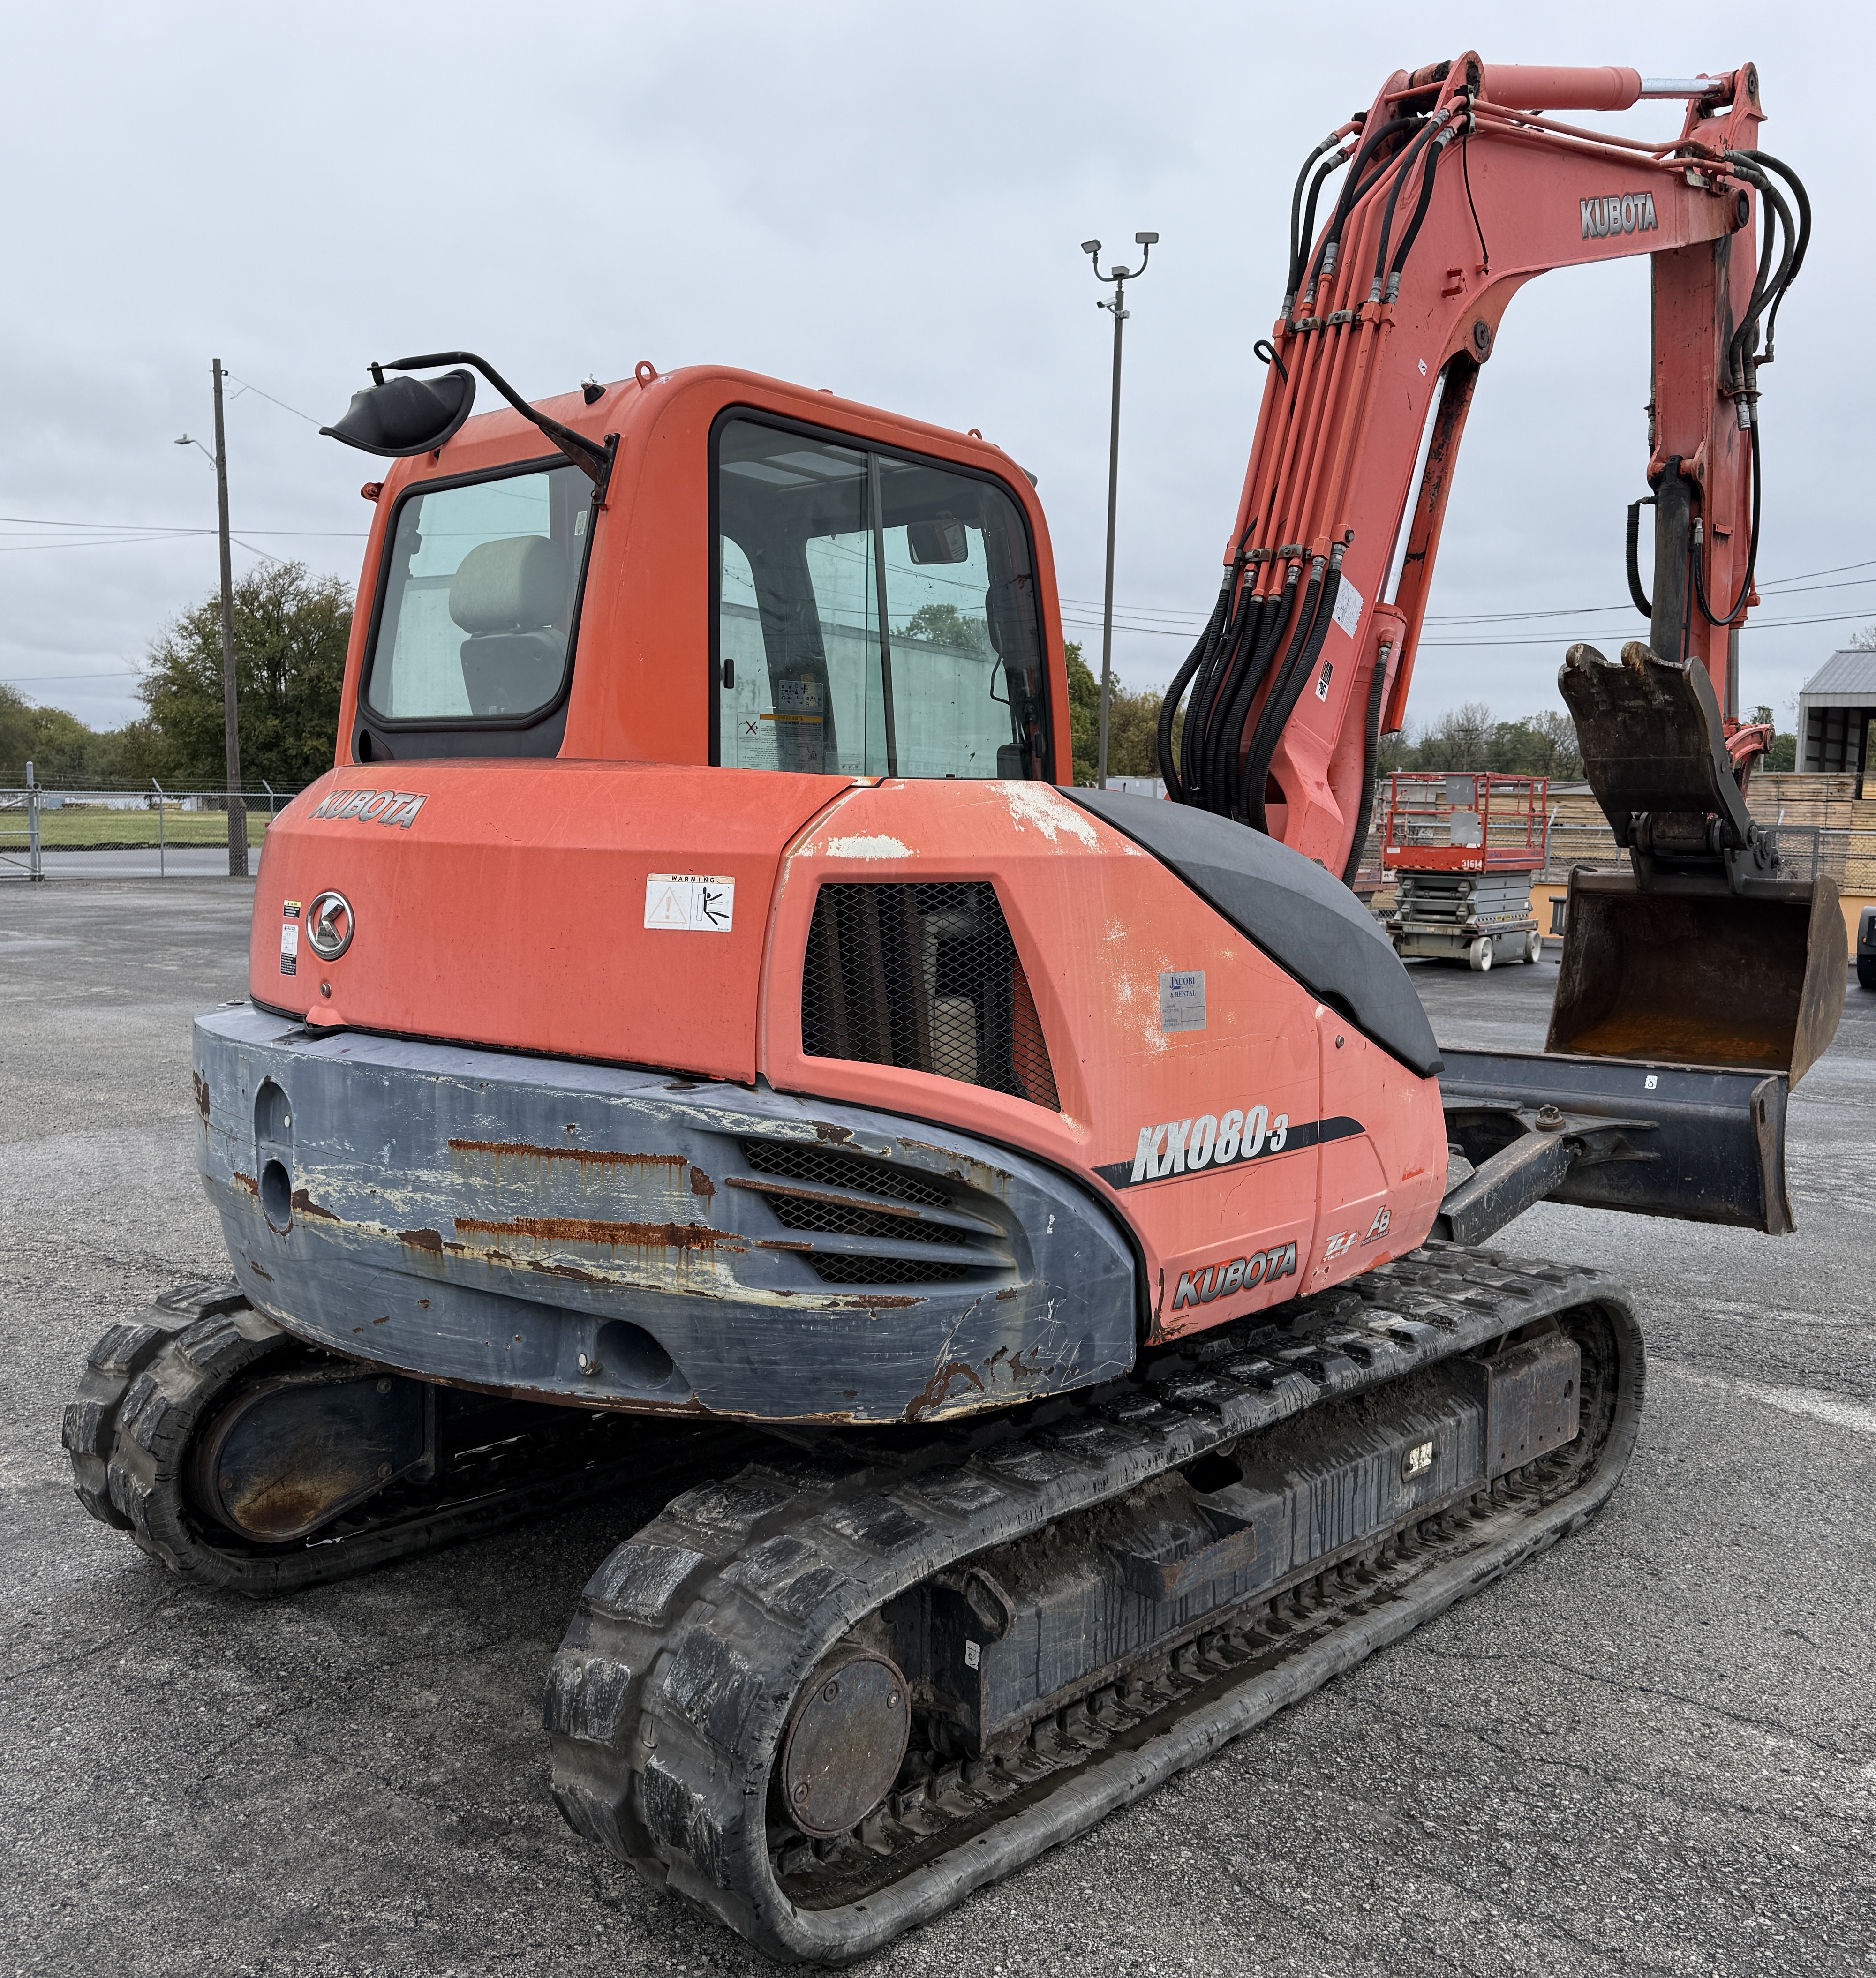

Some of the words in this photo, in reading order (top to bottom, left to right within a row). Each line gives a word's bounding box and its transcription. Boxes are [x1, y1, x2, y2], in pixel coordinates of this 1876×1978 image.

[1580, 193, 1658, 240] KUBOTA
[308, 789, 429, 828] KUBOTA
[1462, 859, 1482, 868] 31614
[1170, 977, 1195, 988] JACOBI
[1130, 1104, 1289, 1183] KX080-3
[1172, 1241, 1297, 1310] KUBOTA
